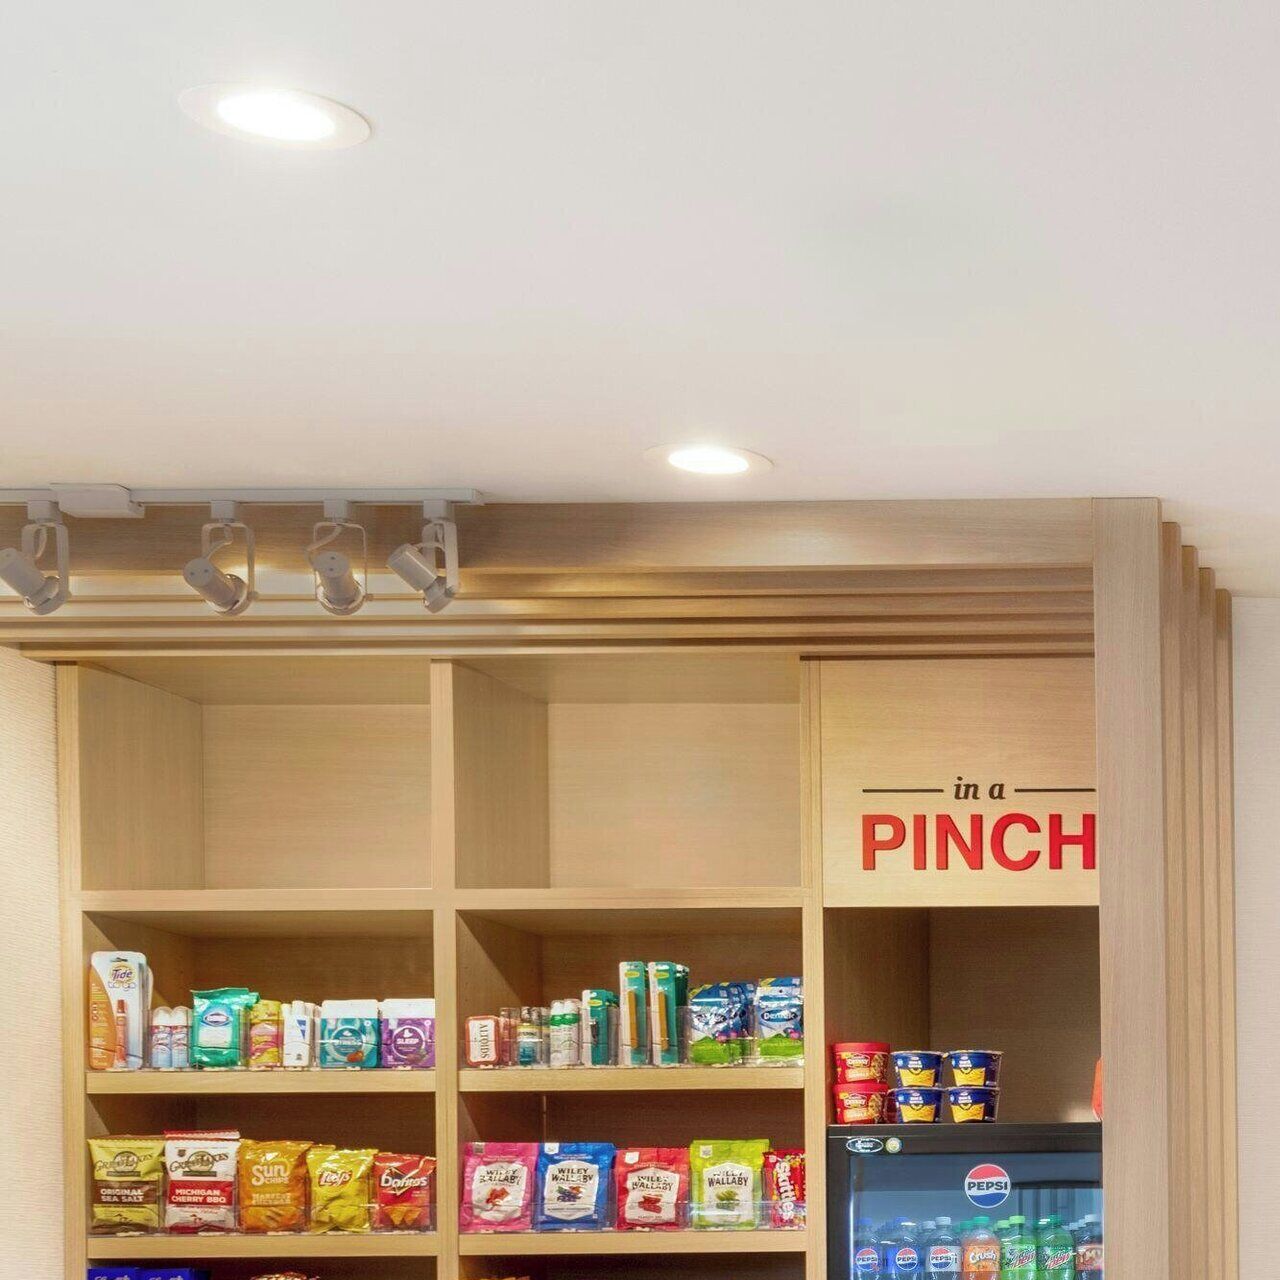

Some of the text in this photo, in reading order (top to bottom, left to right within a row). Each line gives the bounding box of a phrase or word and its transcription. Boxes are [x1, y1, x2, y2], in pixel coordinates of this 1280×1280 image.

[954, 776, 1006, 800] in a
[862, 813, 1096, 871] PINCH
[112, 968, 133, 980] Tide
[252, 1163, 288, 1186] Sun
[381, 1169, 428, 1187] Doritos
[551, 1173, 594, 1183] WALLABY
[707, 1176, 749, 1187] WALLABY
[775, 1159, 798, 1221] Skittles
[967, 1181, 1008, 1191] PEPSI
